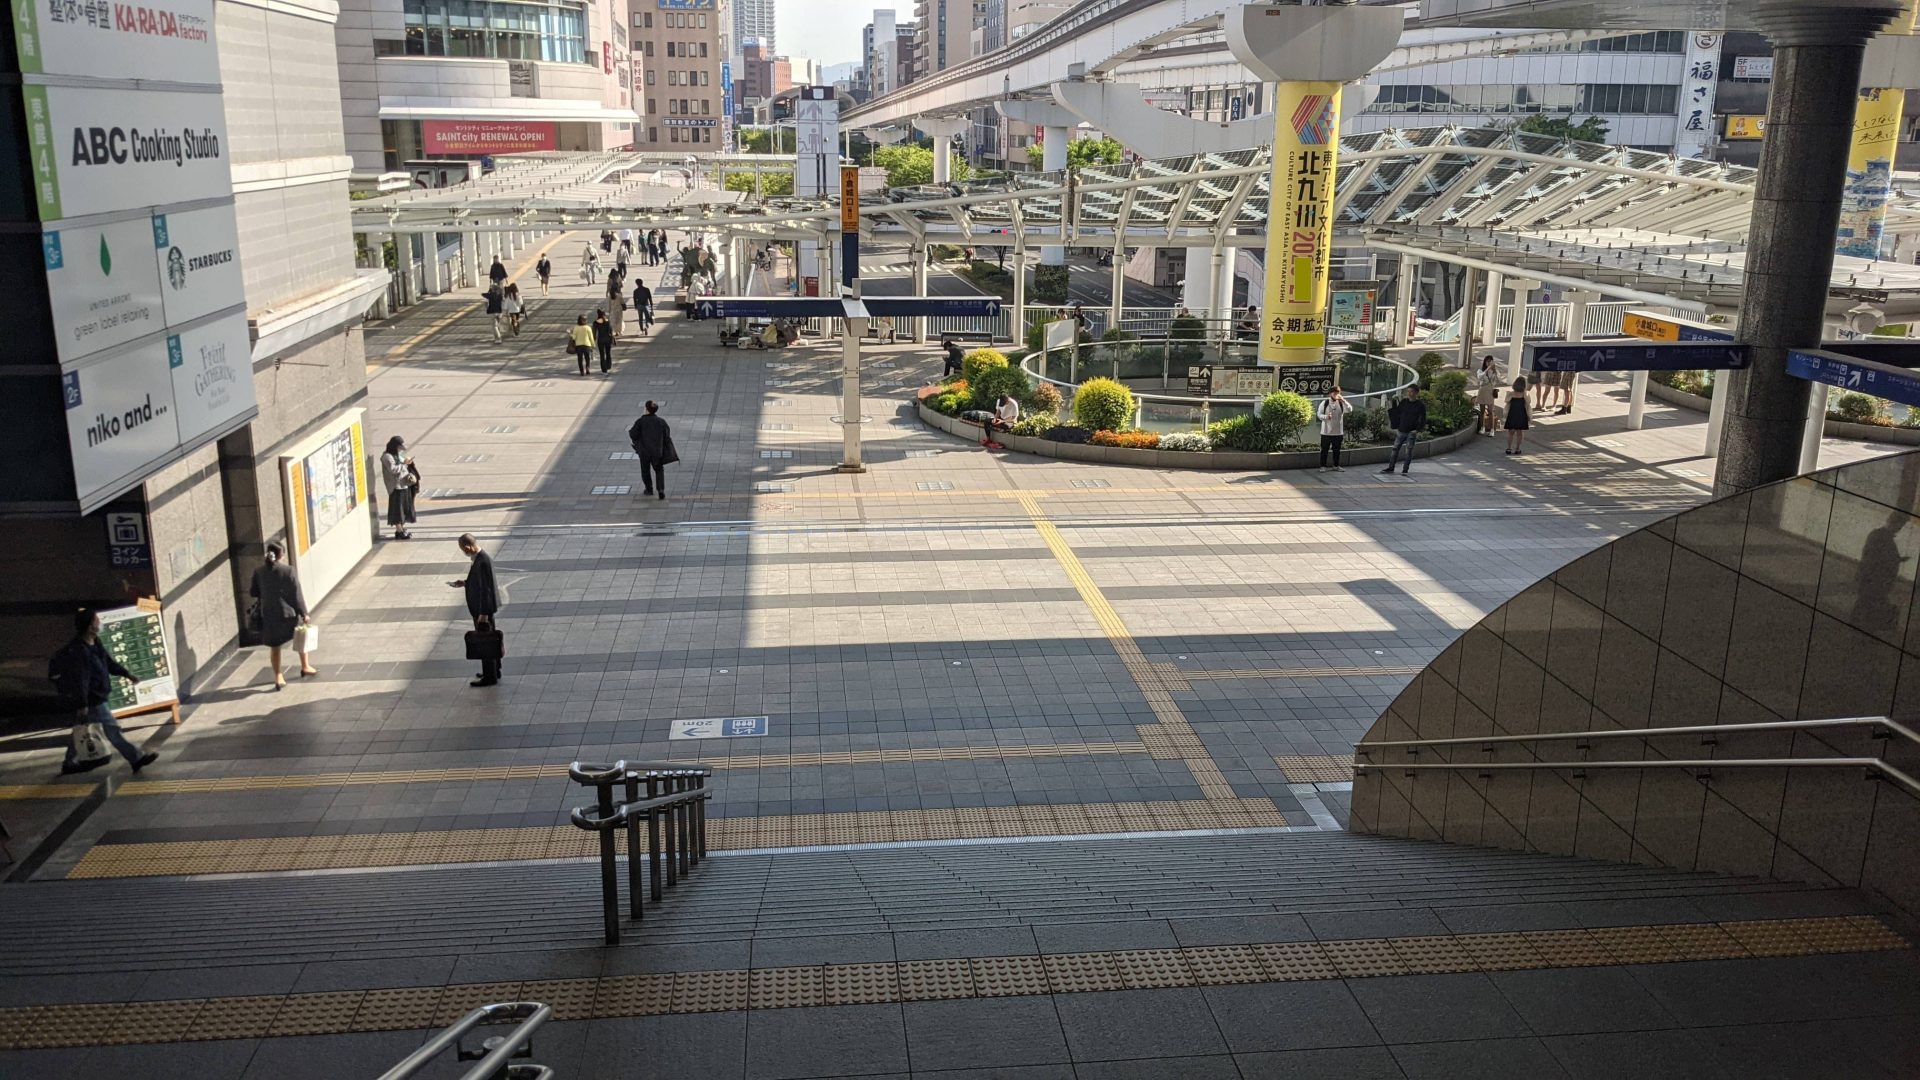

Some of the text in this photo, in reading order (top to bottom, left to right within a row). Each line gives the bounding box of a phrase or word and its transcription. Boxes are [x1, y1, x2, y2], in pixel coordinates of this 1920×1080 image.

[179, 23, 208, 43] factory
[1685, 61, 1713, 131] 福さ屋
[72, 127, 220, 167] ABC Cooking Studio
[481, 132, 518, 141] RENEWAL
[520, 132, 545, 141] OPEN!
[1287, 151, 1295, 181] CULTURE
[1285, 201, 1291, 211] OF
[1314, 150, 1333, 281] 東アジア文化都市
[189, 250, 233, 272] STARBUCKS
[74, 307, 150, 341] green label relaxing
[199, 342, 226, 370] Fruit
[67, 386, 79, 404] 2F
[87, 413, 120, 447] niko
[124, 393, 151, 430] and
[112, 547, 140, 556] コイン
[113, 556, 149, 565] ロッカー
